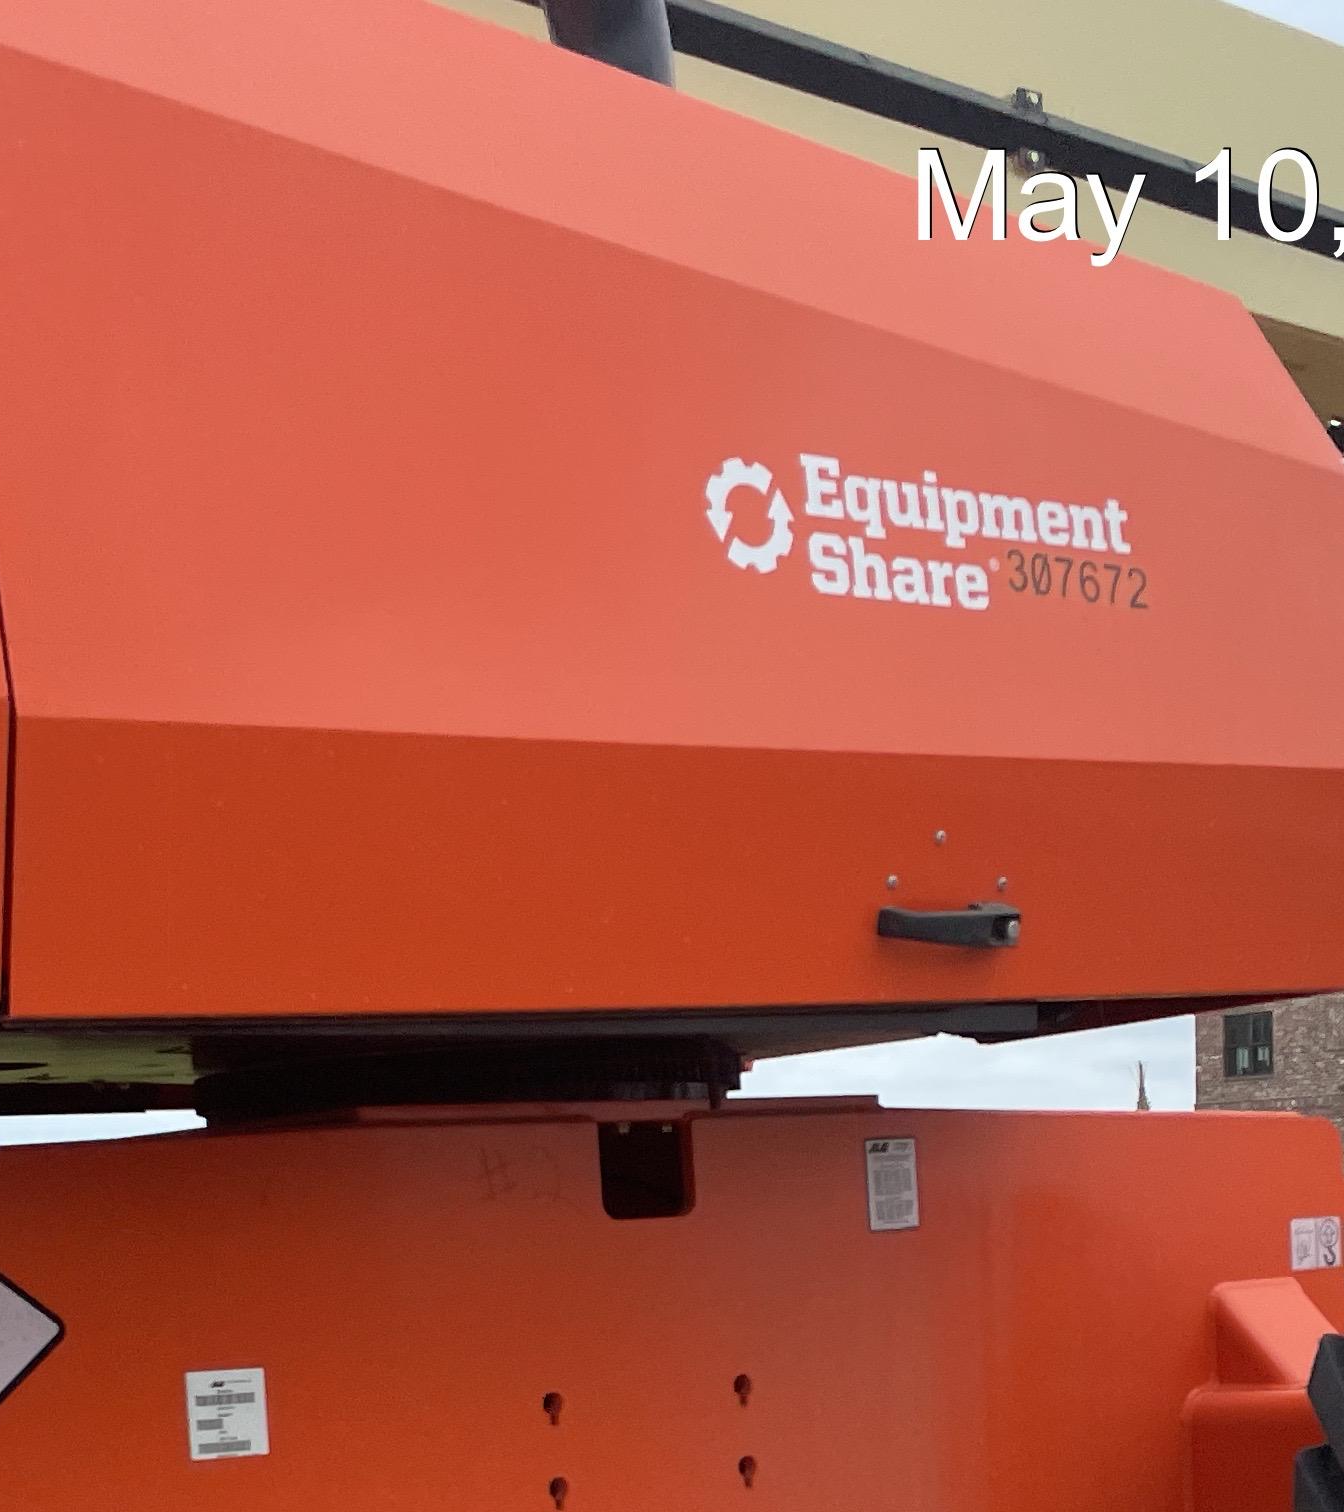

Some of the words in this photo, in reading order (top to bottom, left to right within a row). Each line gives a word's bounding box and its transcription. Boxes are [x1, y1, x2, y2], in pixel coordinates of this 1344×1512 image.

[799, 453, 1132, 555] Equipment
[808, 531, 990, 611] Share
[1006, 549, 1150, 610] 307672
